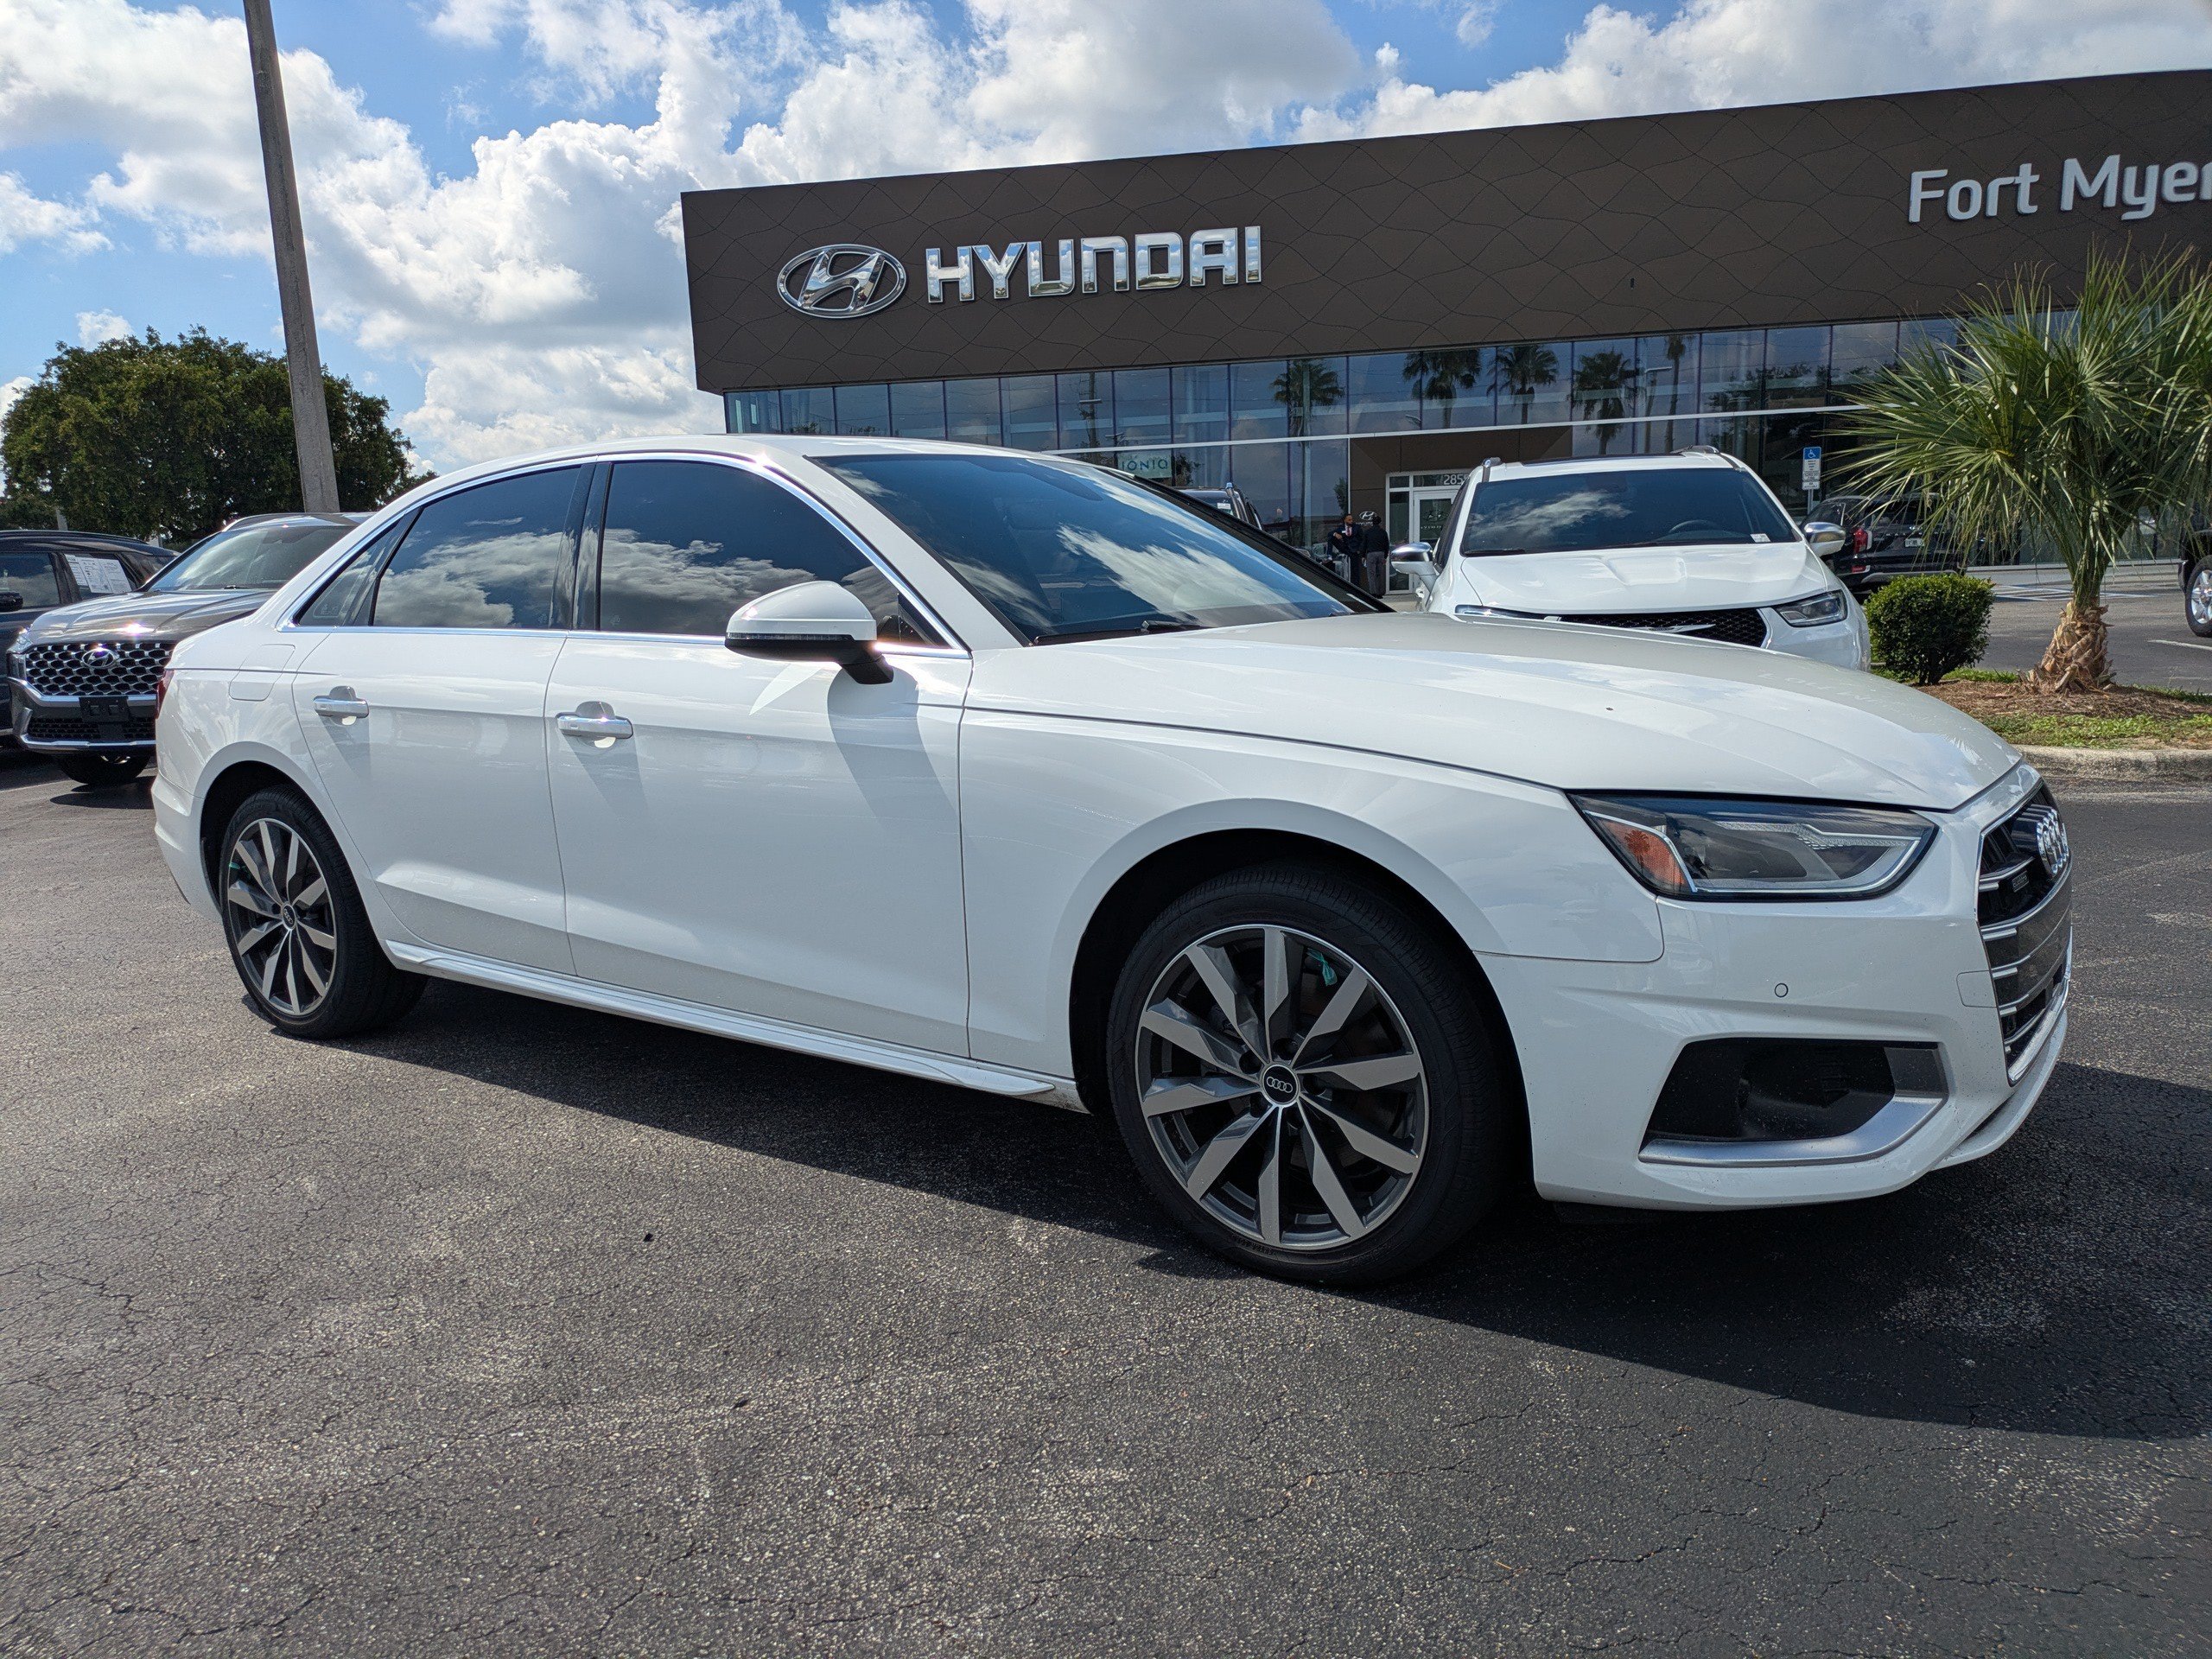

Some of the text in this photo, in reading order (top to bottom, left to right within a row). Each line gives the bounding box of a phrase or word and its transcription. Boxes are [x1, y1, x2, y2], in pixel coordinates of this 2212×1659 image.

[1908, 162, 2040, 224] Fort
[925, 226, 1262, 303] HYUNDAI
[1122, 459, 1168, 471] IONIQ
